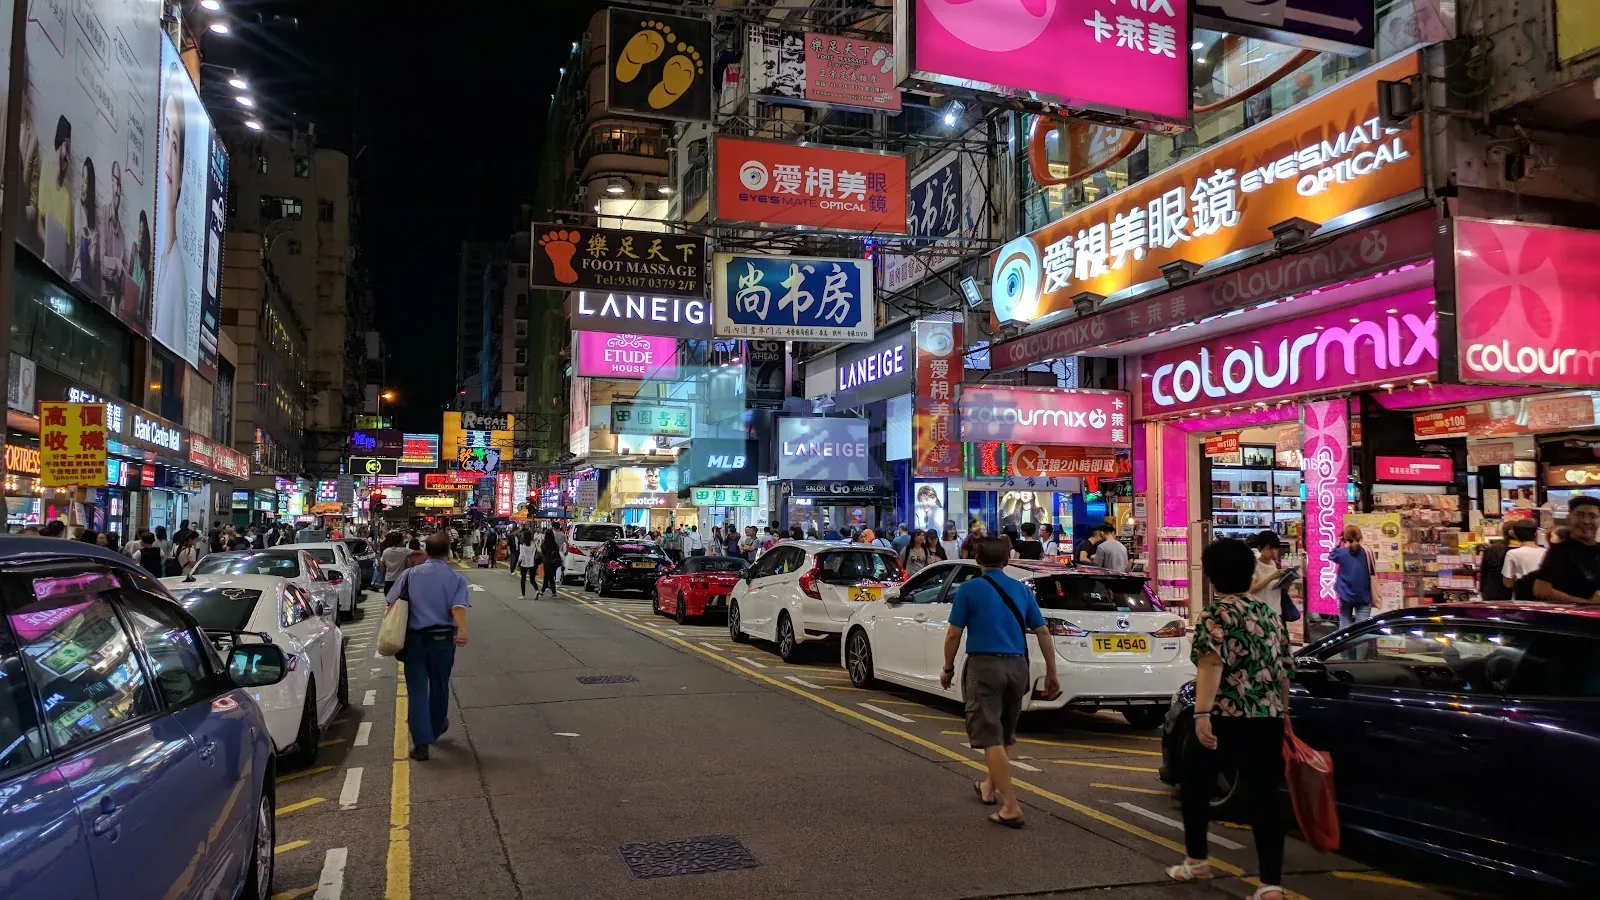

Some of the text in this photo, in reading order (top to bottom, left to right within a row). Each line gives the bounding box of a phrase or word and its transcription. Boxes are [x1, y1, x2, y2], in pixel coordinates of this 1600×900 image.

[1083, 10, 1177, 58] 卡萊美
[811, 38, 871, 57] 樂足天下
[1296, 137, 1409, 197] OPTICAL
[773, 164, 867, 201] 愛視美
[820, 200, 866, 212] OPTICAL
[1042, 168, 1241, 294] 愛視美眼鏡
[585, 235, 697, 263] 樂足天下
[582, 259, 697, 277] FOOT MASSAGE
[649, 277, 676, 289] 0379
[678, 280, 697, 291] 2/F
[579, 291, 713, 325] LANEIG
[1127, 295, 1188, 327] 卡萊美
[604, 349, 653, 364] ETUDE
[752, 353, 779, 361] AHEAD
[612, 364, 645, 373] HOUSE
[840, 345, 905, 391] LANEIGE
[44, 406, 103, 427] 高價
[463, 411, 507, 429] REGAL
[616, 410, 690, 428] 田園書屋
[929, 359, 950, 464] 愛視美眼鏡
[1111, 397, 1125, 443] 卡萊美
[1443, 415, 1465, 427] $100
[44, 431, 105, 451] 收機
[135, 415, 151, 442] Bank
[151, 422, 169, 447] Centre
[169, 429, 180, 451] Mall
[783, 441, 866, 458] LANEIGE
[1223, 439, 1237, 448] $100
[707, 455, 747, 469] MLB
[1036, 459, 1115, 473] 配鏡2小時即取
[696, 490, 756, 503] 田園書屋
[830, 483, 850, 494] Go
[625, 497, 659, 505] swatch
[1095, 639, 1111, 650] TE
[1117, 639, 1146, 650] 4540
